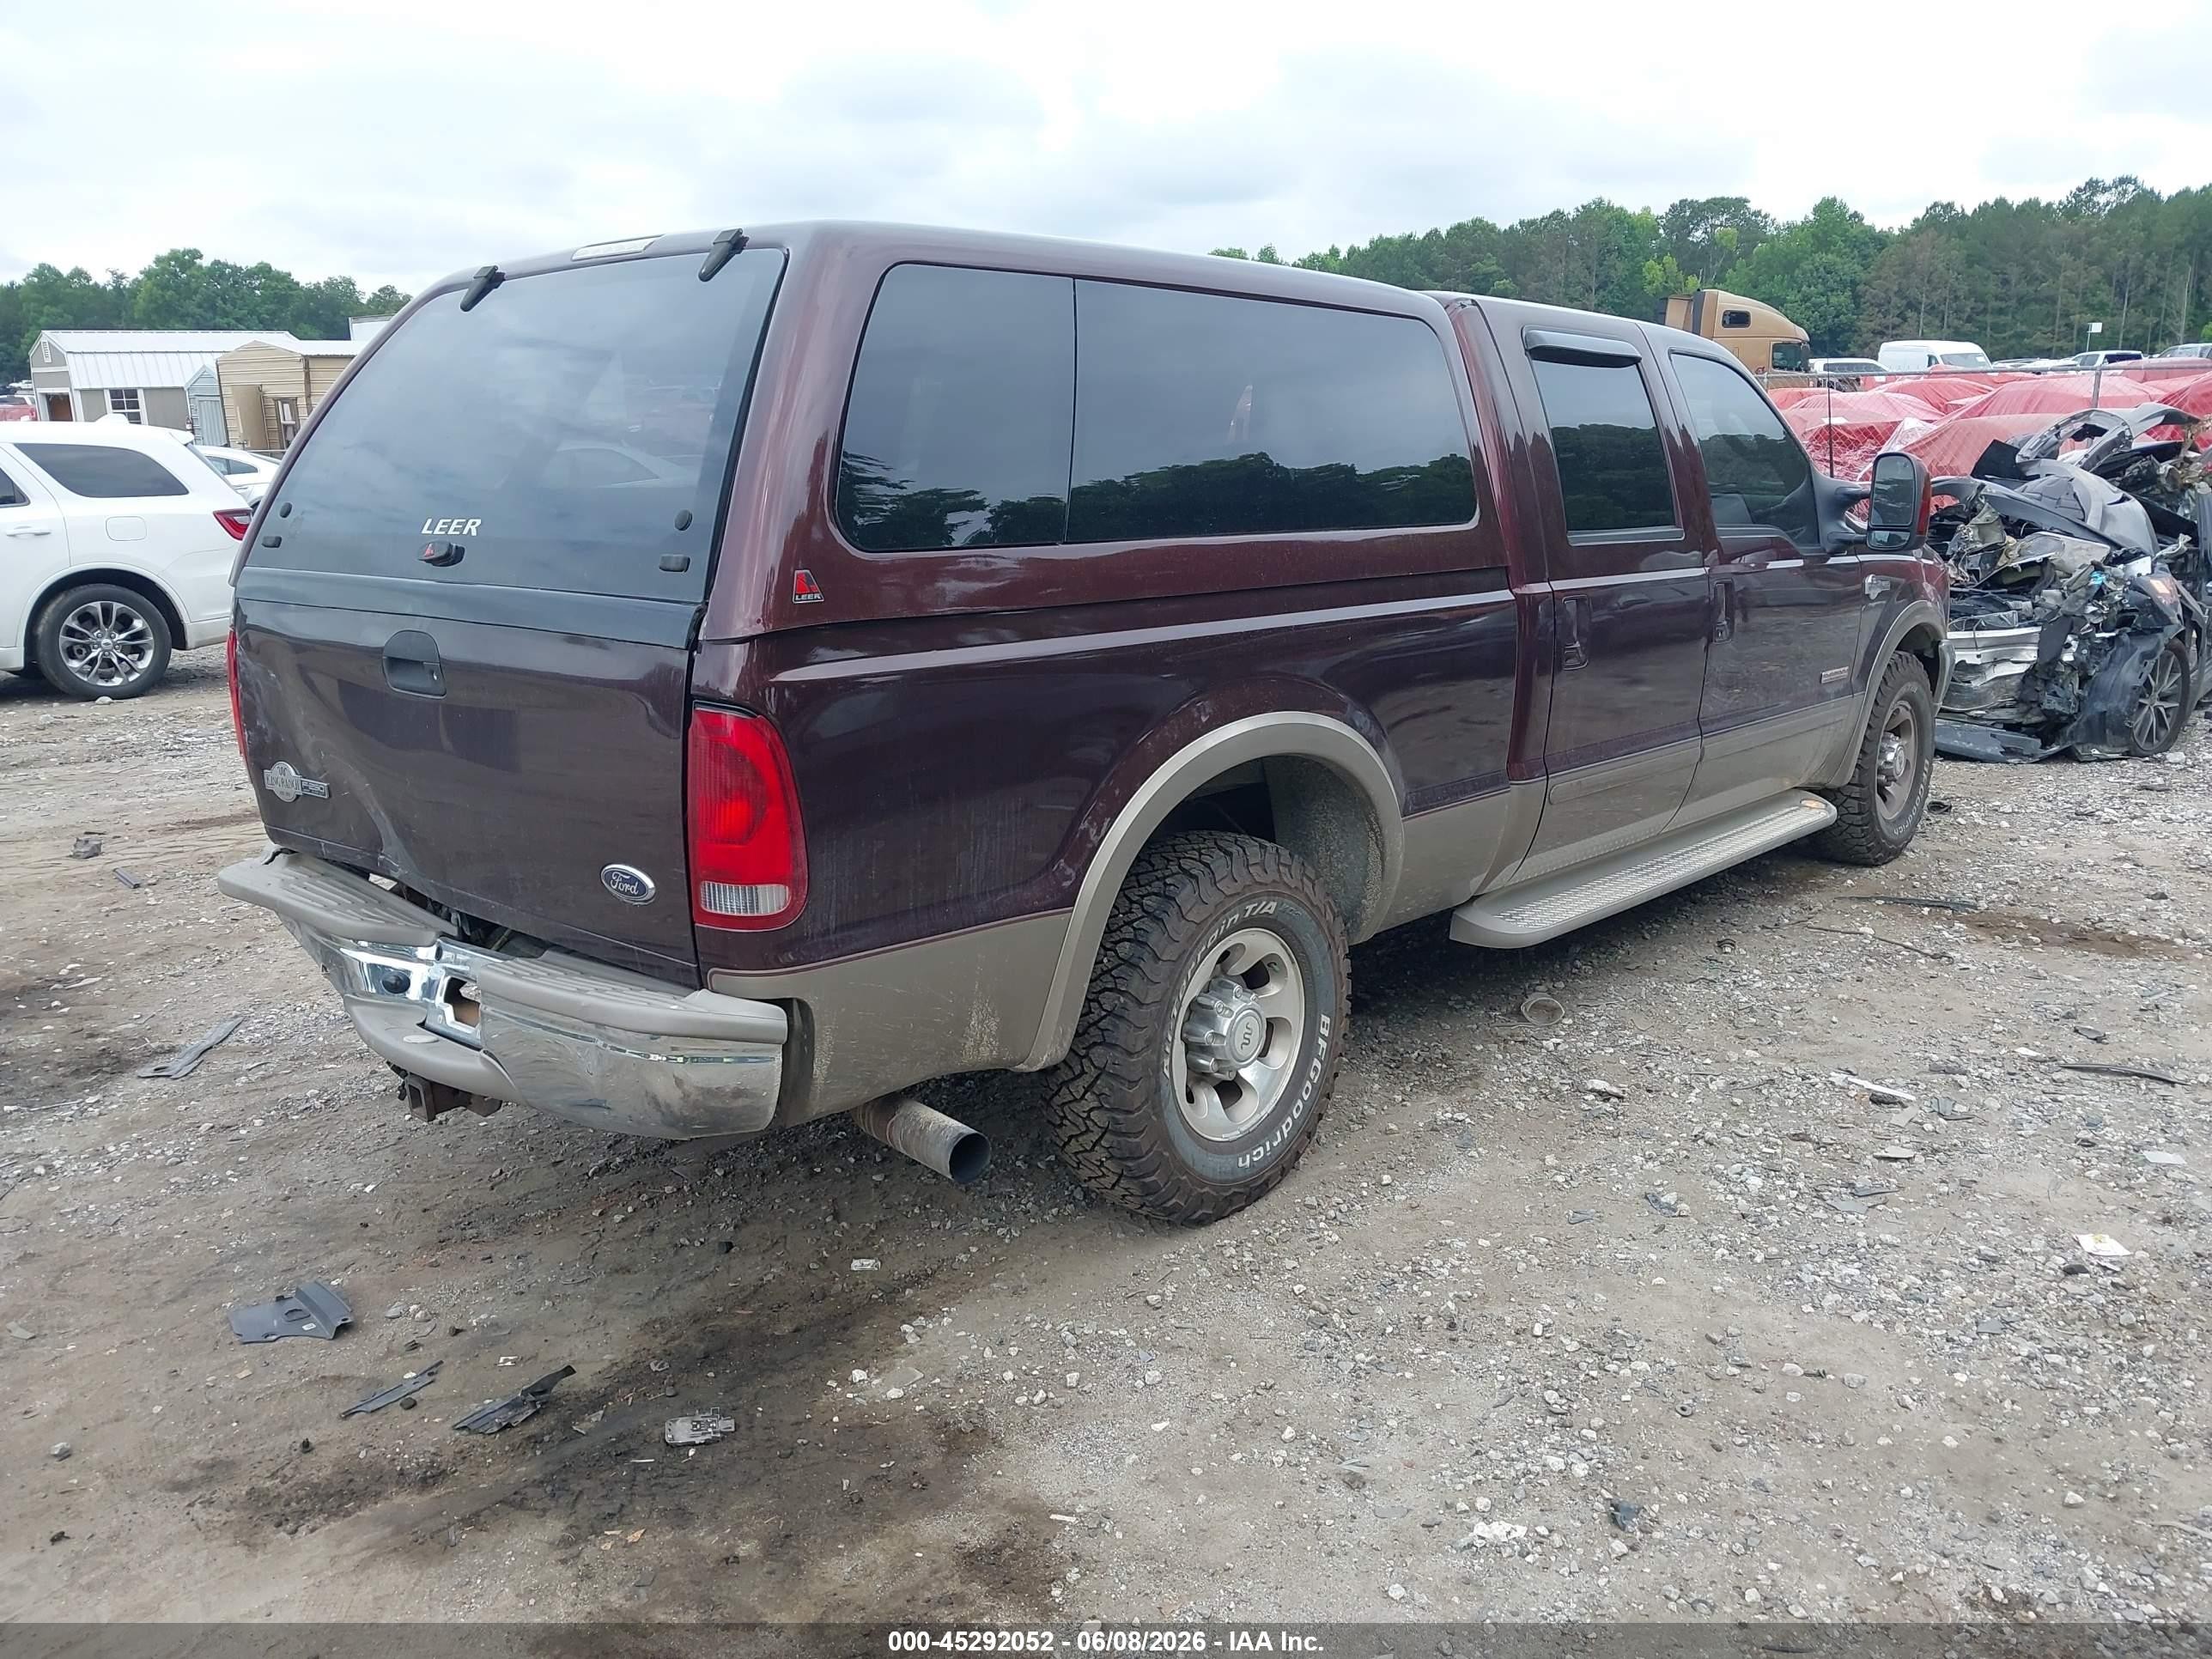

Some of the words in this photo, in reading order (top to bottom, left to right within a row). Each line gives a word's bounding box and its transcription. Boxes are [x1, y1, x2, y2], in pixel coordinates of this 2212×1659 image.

[421, 518, 482, 537] LEER
[611, 871, 639, 895] Ford
[1243, 901, 1278, 918] T/A
[1237, 1014, 1331, 1169] BFGoodrich
